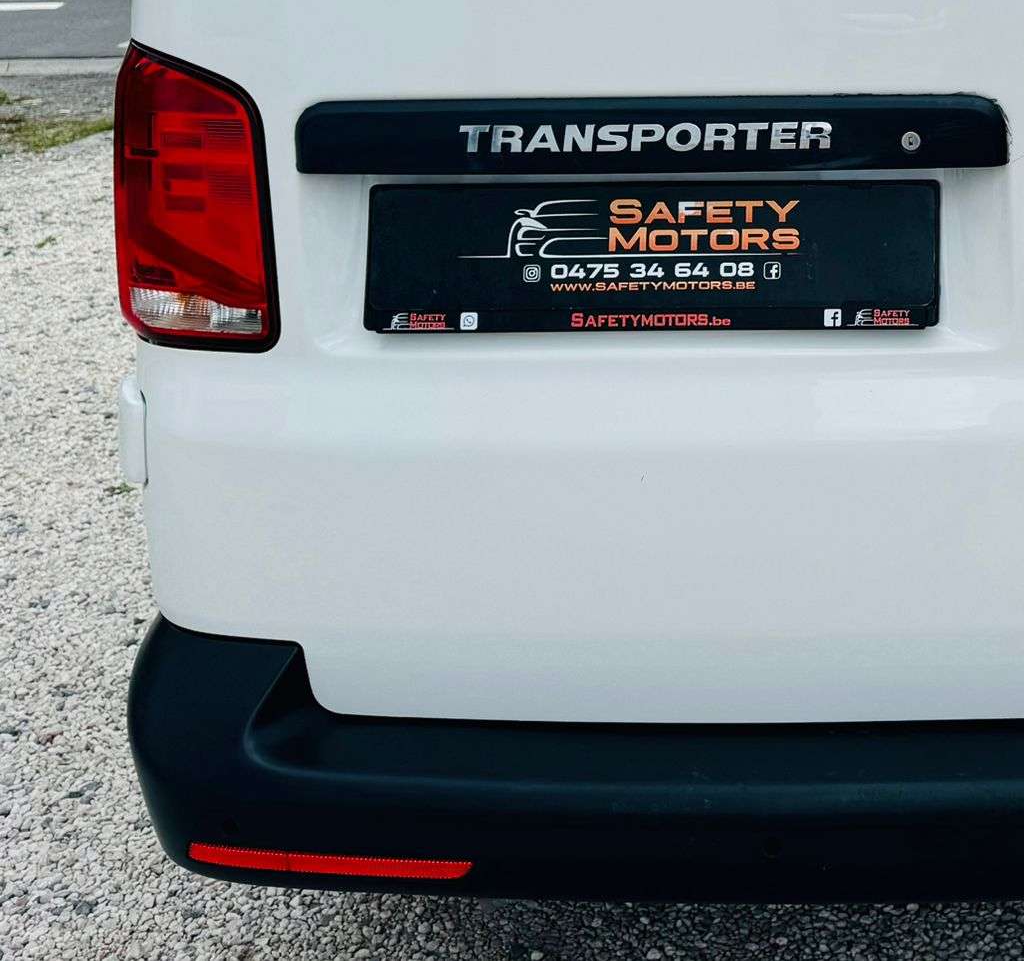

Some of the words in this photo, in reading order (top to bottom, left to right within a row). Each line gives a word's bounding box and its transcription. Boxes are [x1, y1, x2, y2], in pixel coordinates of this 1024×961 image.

[459, 121, 833, 153] TRANSPORTER
[609, 198, 800, 225] SAFETY
[608, 226, 800, 252] MOTORS
[550, 263, 619, 280] 0475
[629, 262, 665, 279] 34
[674, 262, 710, 278] 64
[719, 261, 755, 277] 08
[873, 308, 910, 317] SAFETY
